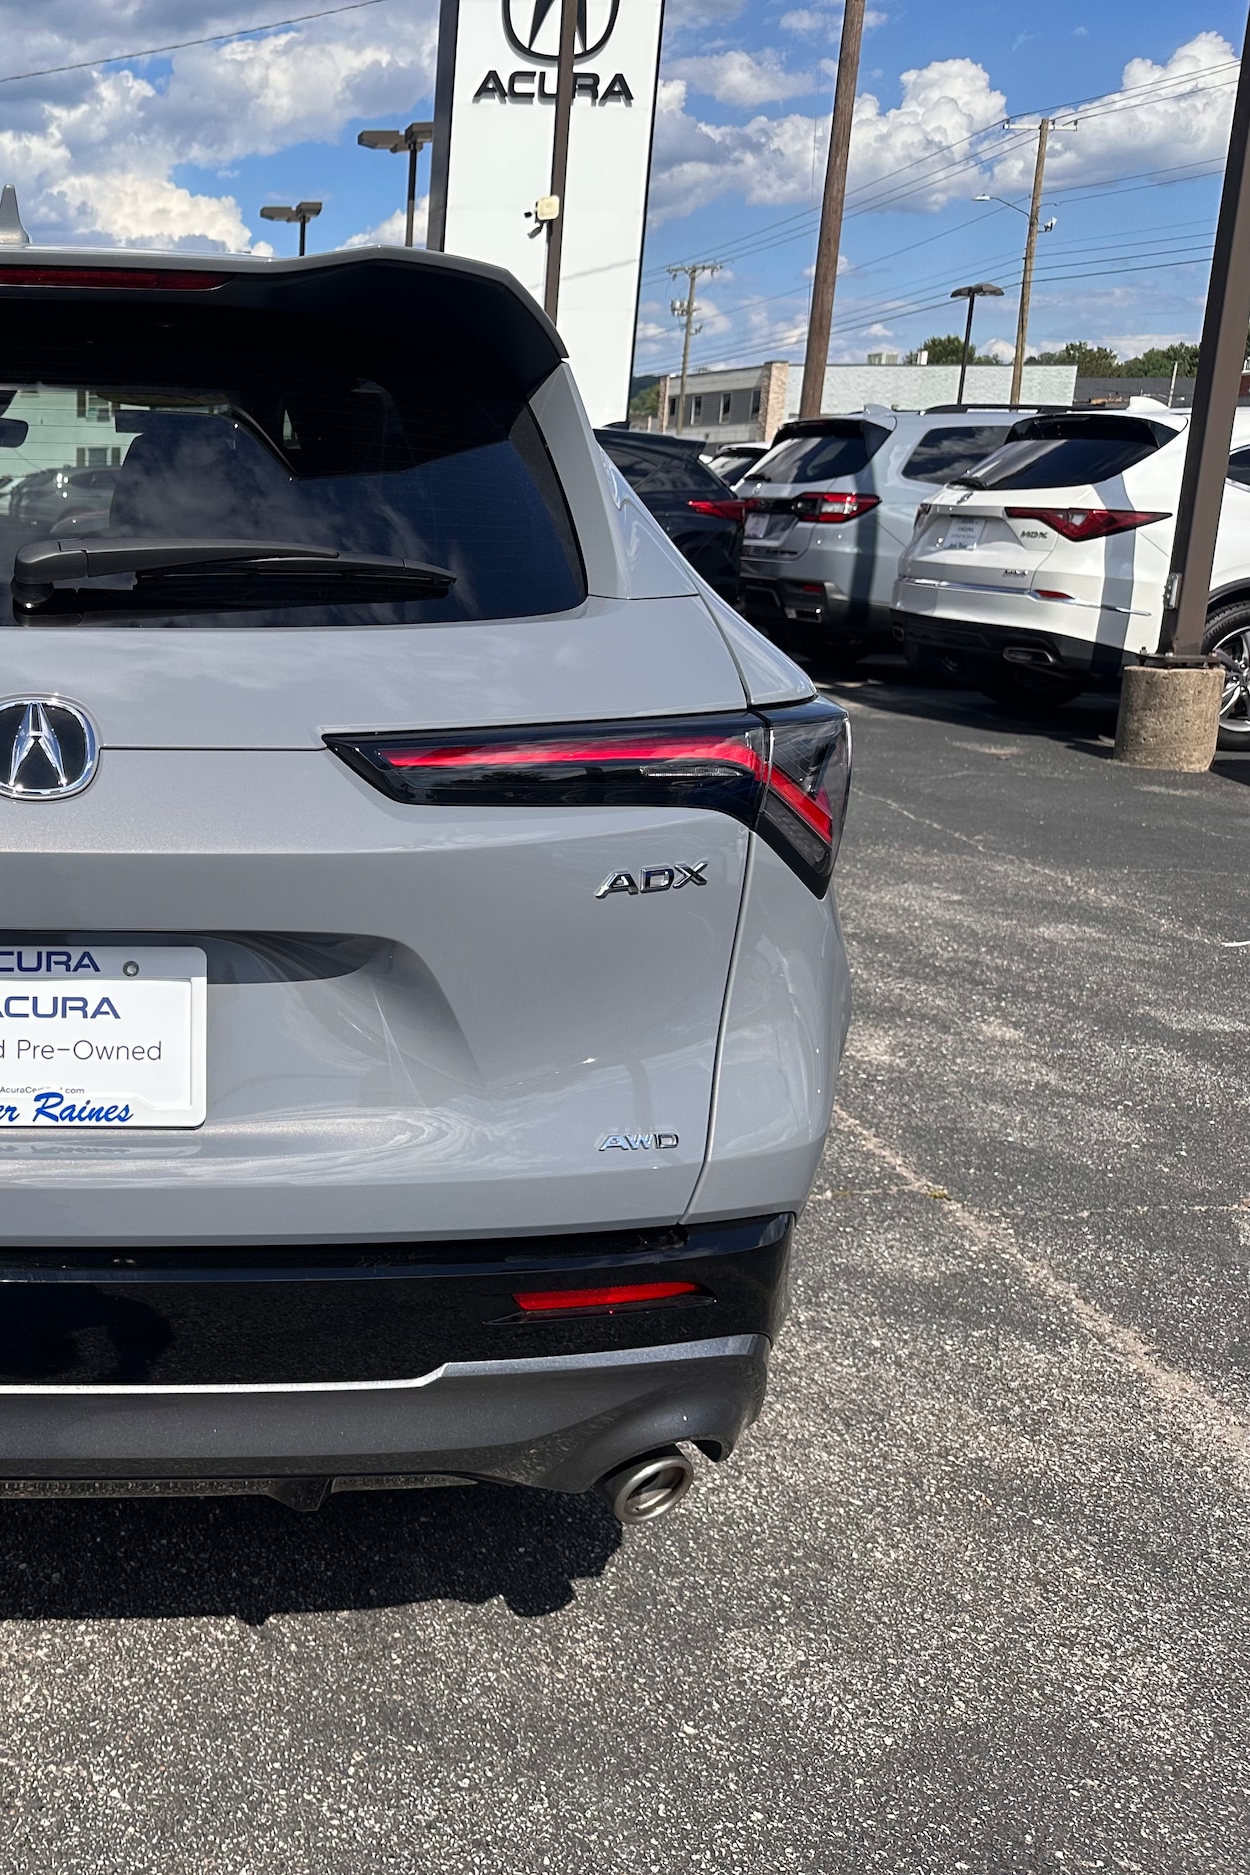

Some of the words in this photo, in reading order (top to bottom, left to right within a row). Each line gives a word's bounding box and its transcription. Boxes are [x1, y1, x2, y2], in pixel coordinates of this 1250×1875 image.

[472, 70, 634, 106] ACURA
[594, 859, 708, 899] ADX
[17, 1039, 162, 1061] Pre-Owned
[32, 1091, 134, 1124] Raines
[598, 1132, 679, 1152] AWD
